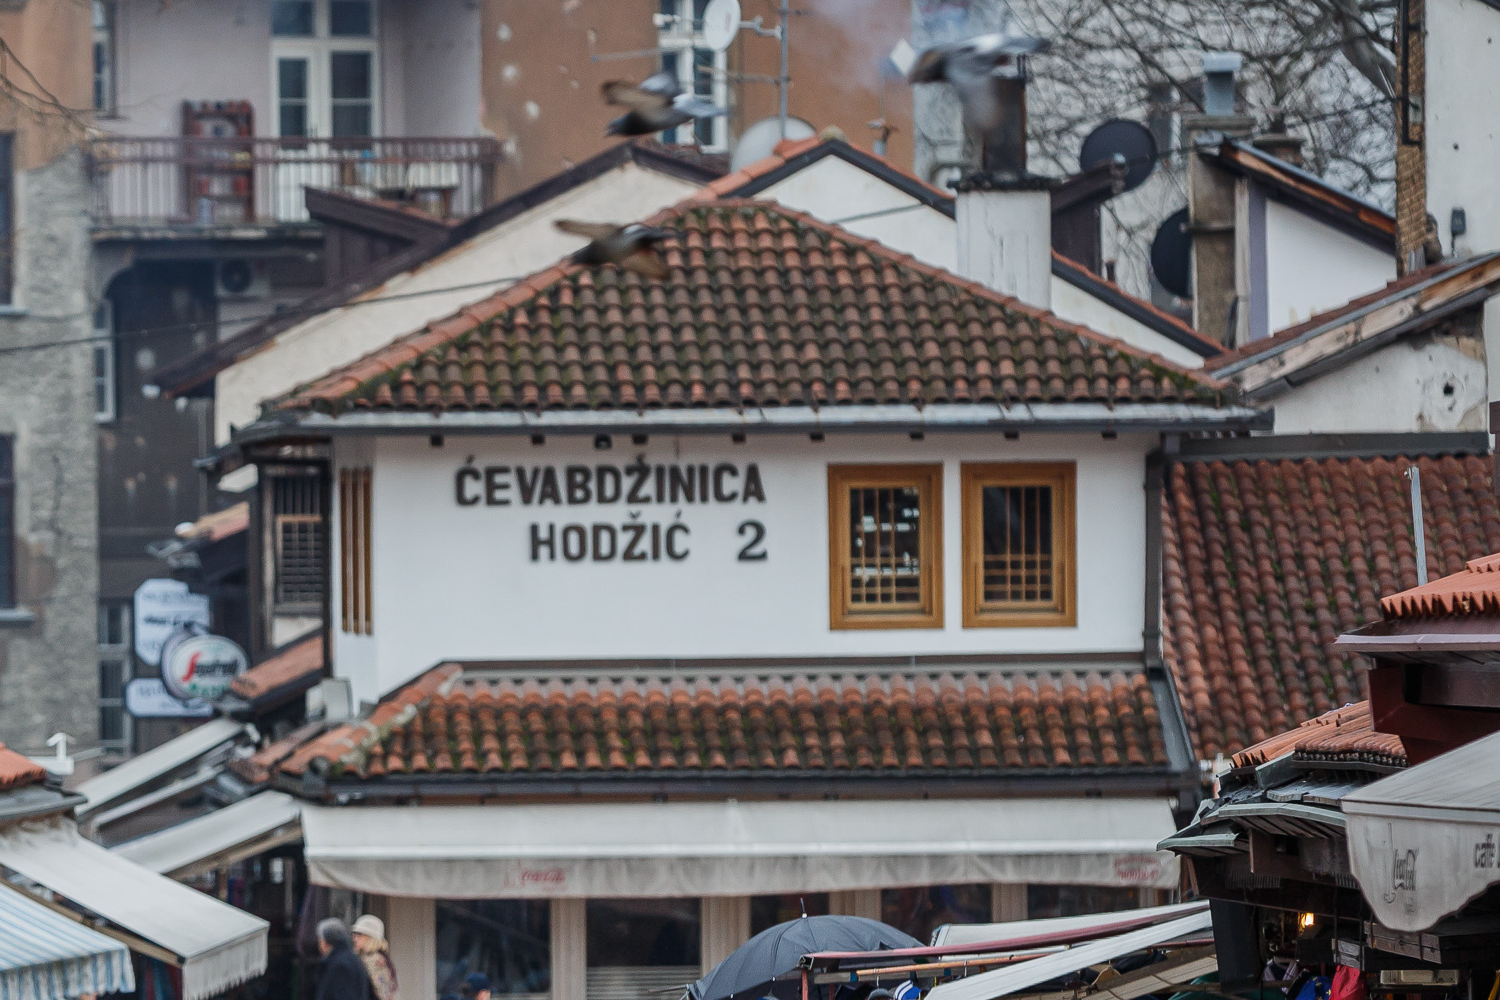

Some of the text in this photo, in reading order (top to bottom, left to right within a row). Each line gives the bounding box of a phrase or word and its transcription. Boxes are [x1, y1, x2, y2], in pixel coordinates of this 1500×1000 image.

[454, 453, 767, 506] ĆEVABDŽINICA
[529, 509, 768, 562] HODŽIĆ 2
